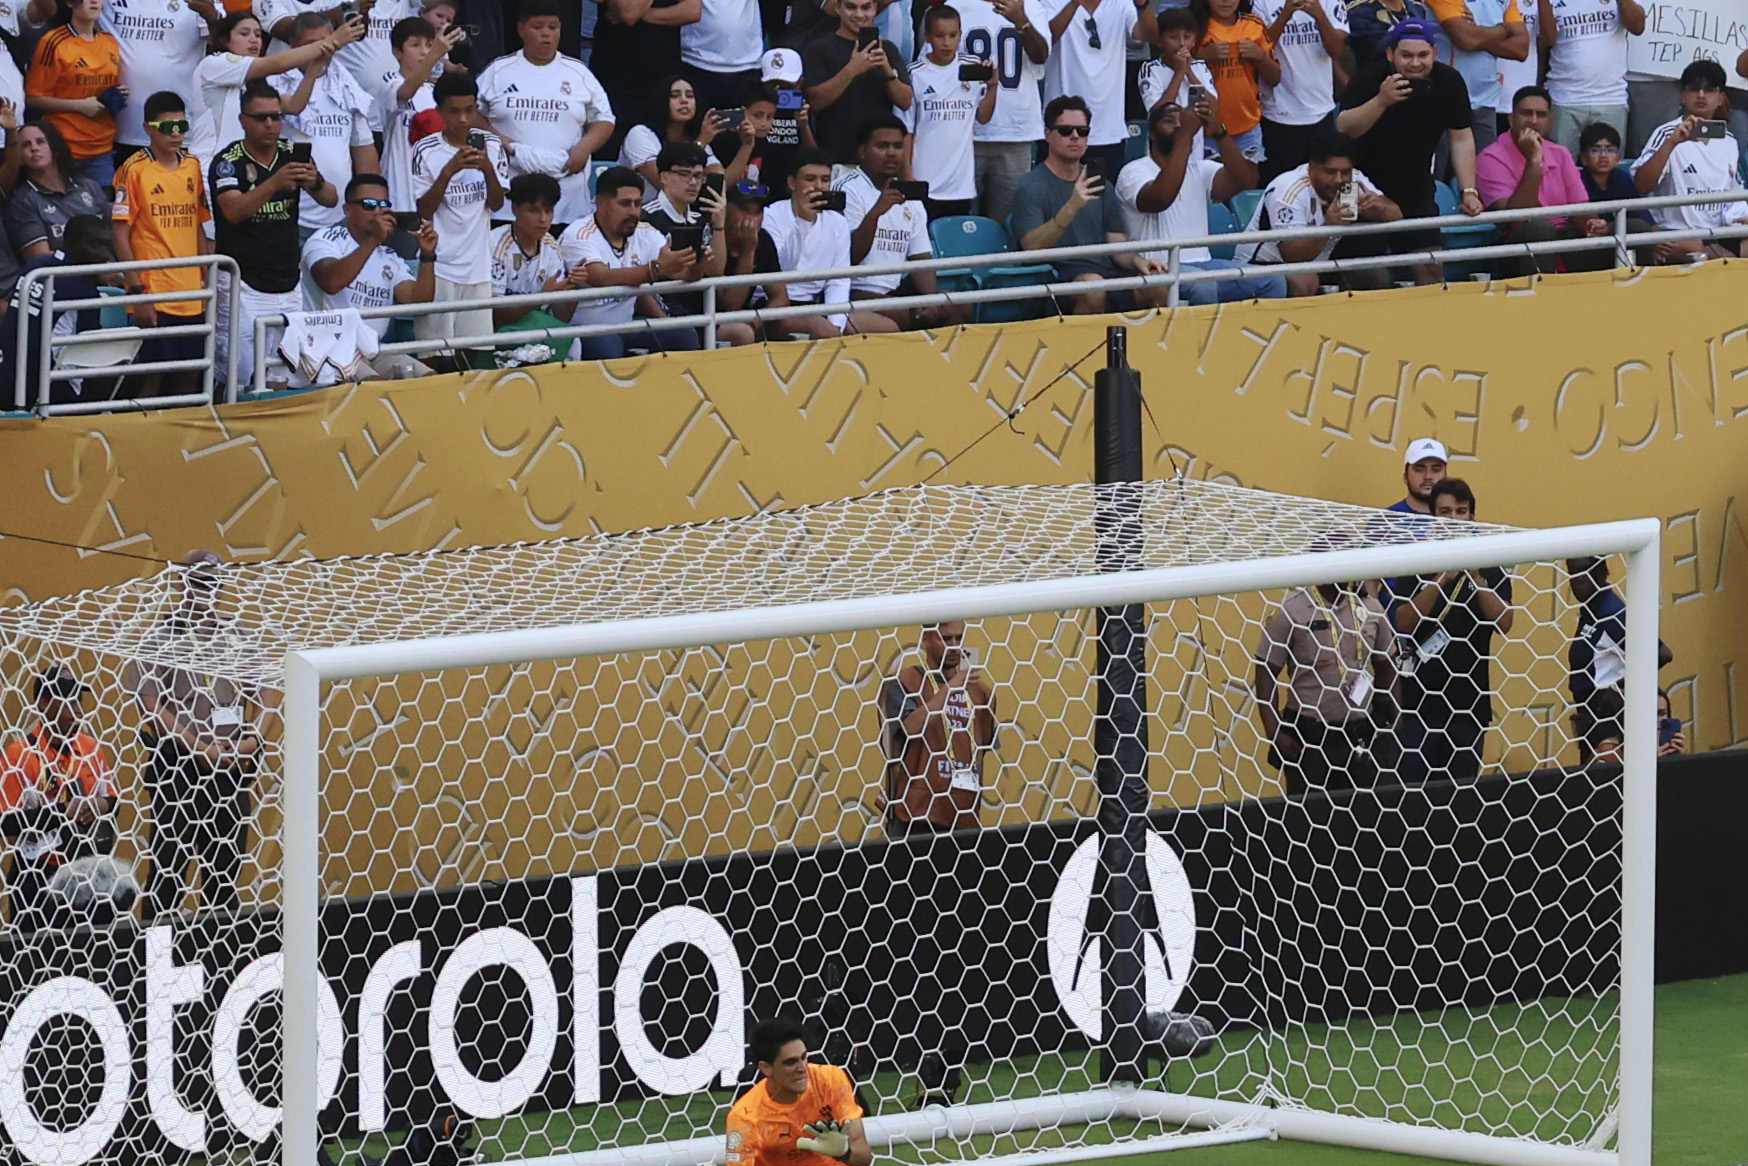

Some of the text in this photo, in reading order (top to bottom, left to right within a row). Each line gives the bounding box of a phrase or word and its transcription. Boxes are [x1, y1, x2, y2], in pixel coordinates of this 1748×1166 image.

[113, 11, 174, 30] Emirates
[120, 28, 166, 41] FLY BETTER
[505, 96, 570, 111] Emirates
[923, 99, 973, 111] Emirates
[514, 110, 560, 123] FLY BETTER
[930, 111, 967, 121] FLY BETTER
[150, 202, 197, 216] Emirates
[304, 314, 343, 327] Emirates
